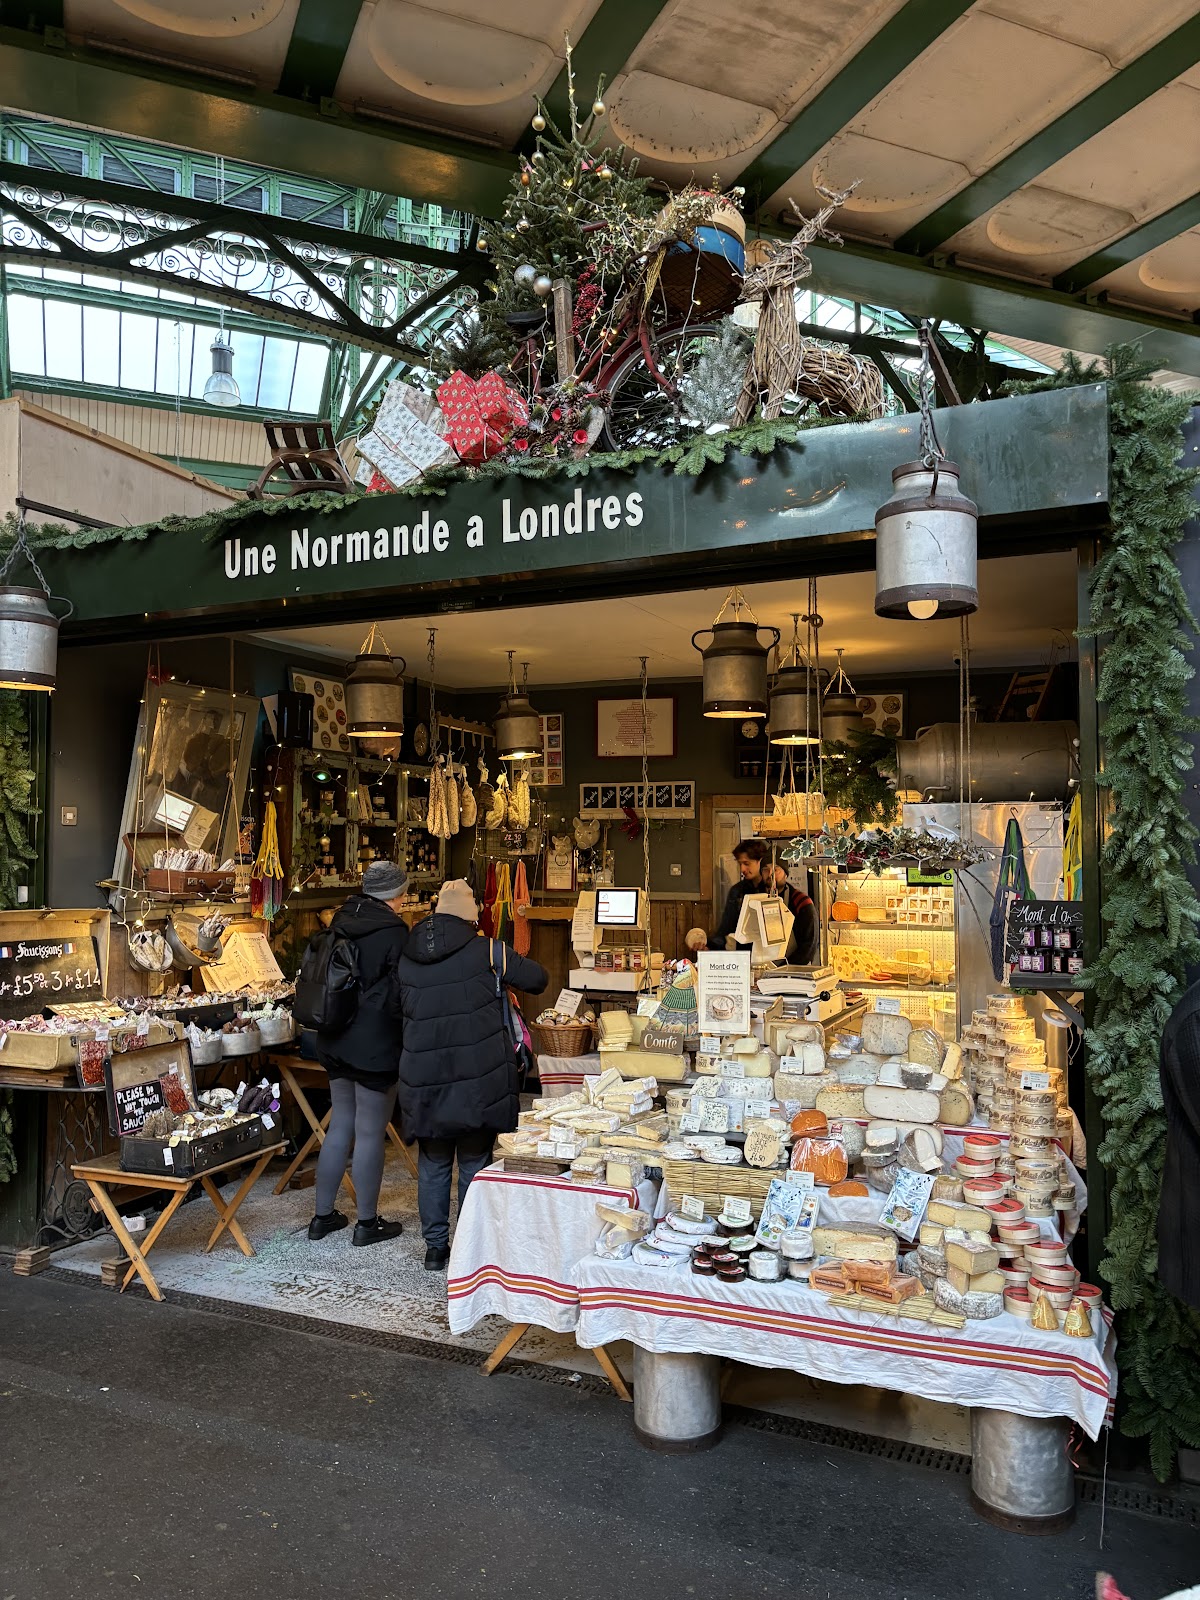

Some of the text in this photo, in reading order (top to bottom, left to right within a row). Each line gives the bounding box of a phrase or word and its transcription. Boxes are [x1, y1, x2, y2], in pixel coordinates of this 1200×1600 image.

[224, 488, 644, 579] Une Normande a Londres
[1017, 904, 1073, 923] Mont d'Or
[15, 942, 63, 961] Saucissons
[51, 970, 63, 991] 3
[75, 968, 101, 990] £14
[60, 1007, 103, 1016] TOUCH
[116, 1086, 154, 1104] PLEASE DO
[125, 1094, 160, 1113] NOT TOUCH
[134, 1107, 145, 1116] THE
